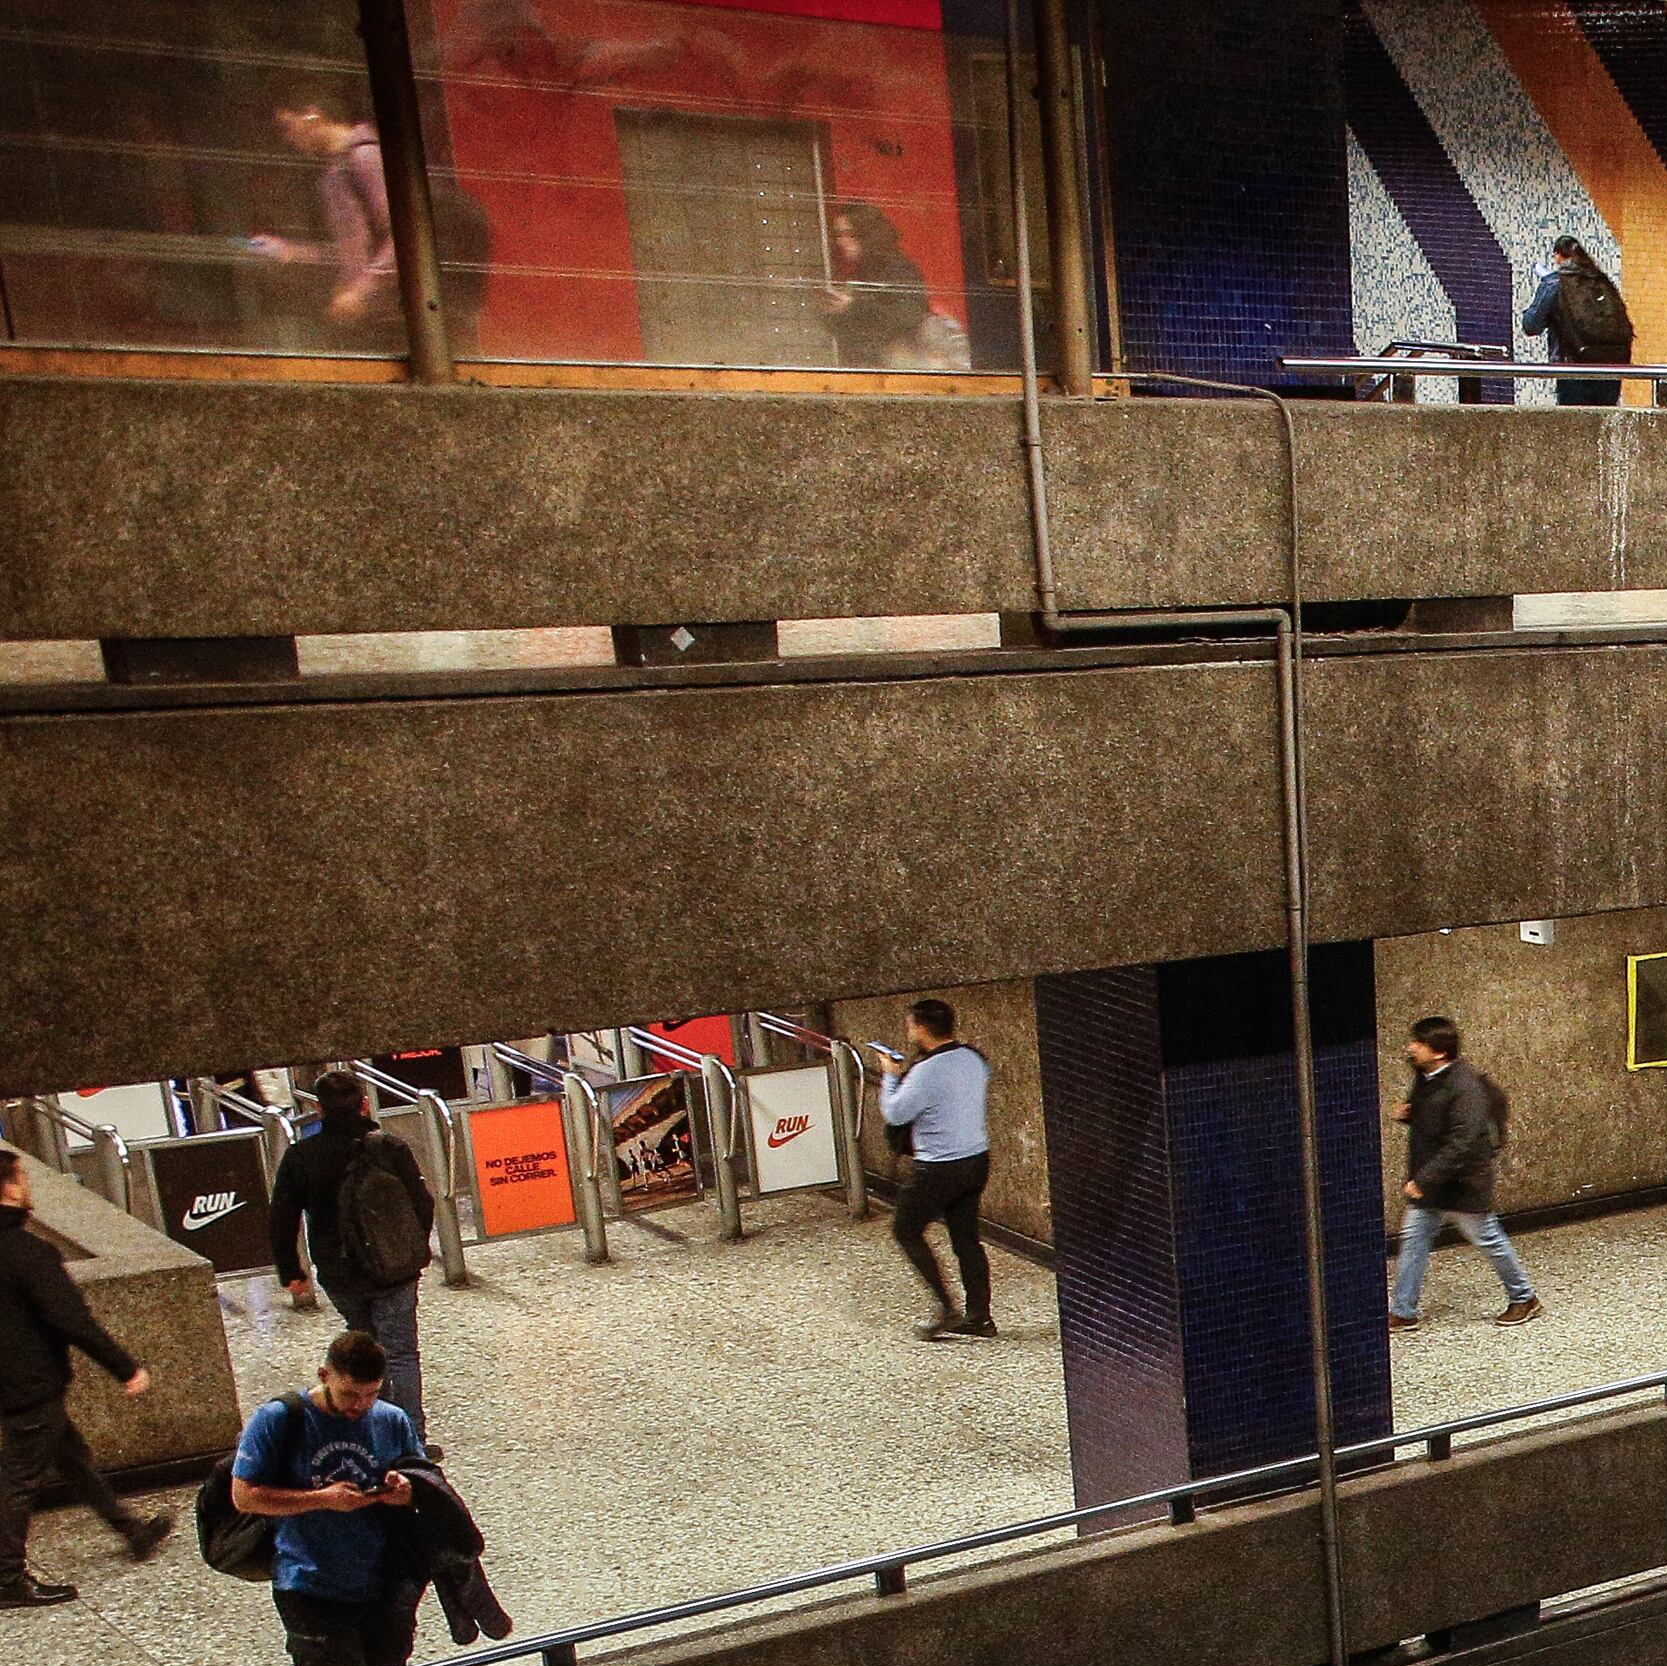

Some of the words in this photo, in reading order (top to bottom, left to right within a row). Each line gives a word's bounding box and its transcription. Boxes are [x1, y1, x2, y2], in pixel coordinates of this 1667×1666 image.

[775, 1114, 810, 1135] RUN
[485, 1158, 502, 1169] NO
[503, 1150, 557, 1166] DEJEMOS
[505, 1162, 540, 1174] CALLE
[490, 1175, 509, 1187] SIN
[192, 1191, 236, 1215] RUN
